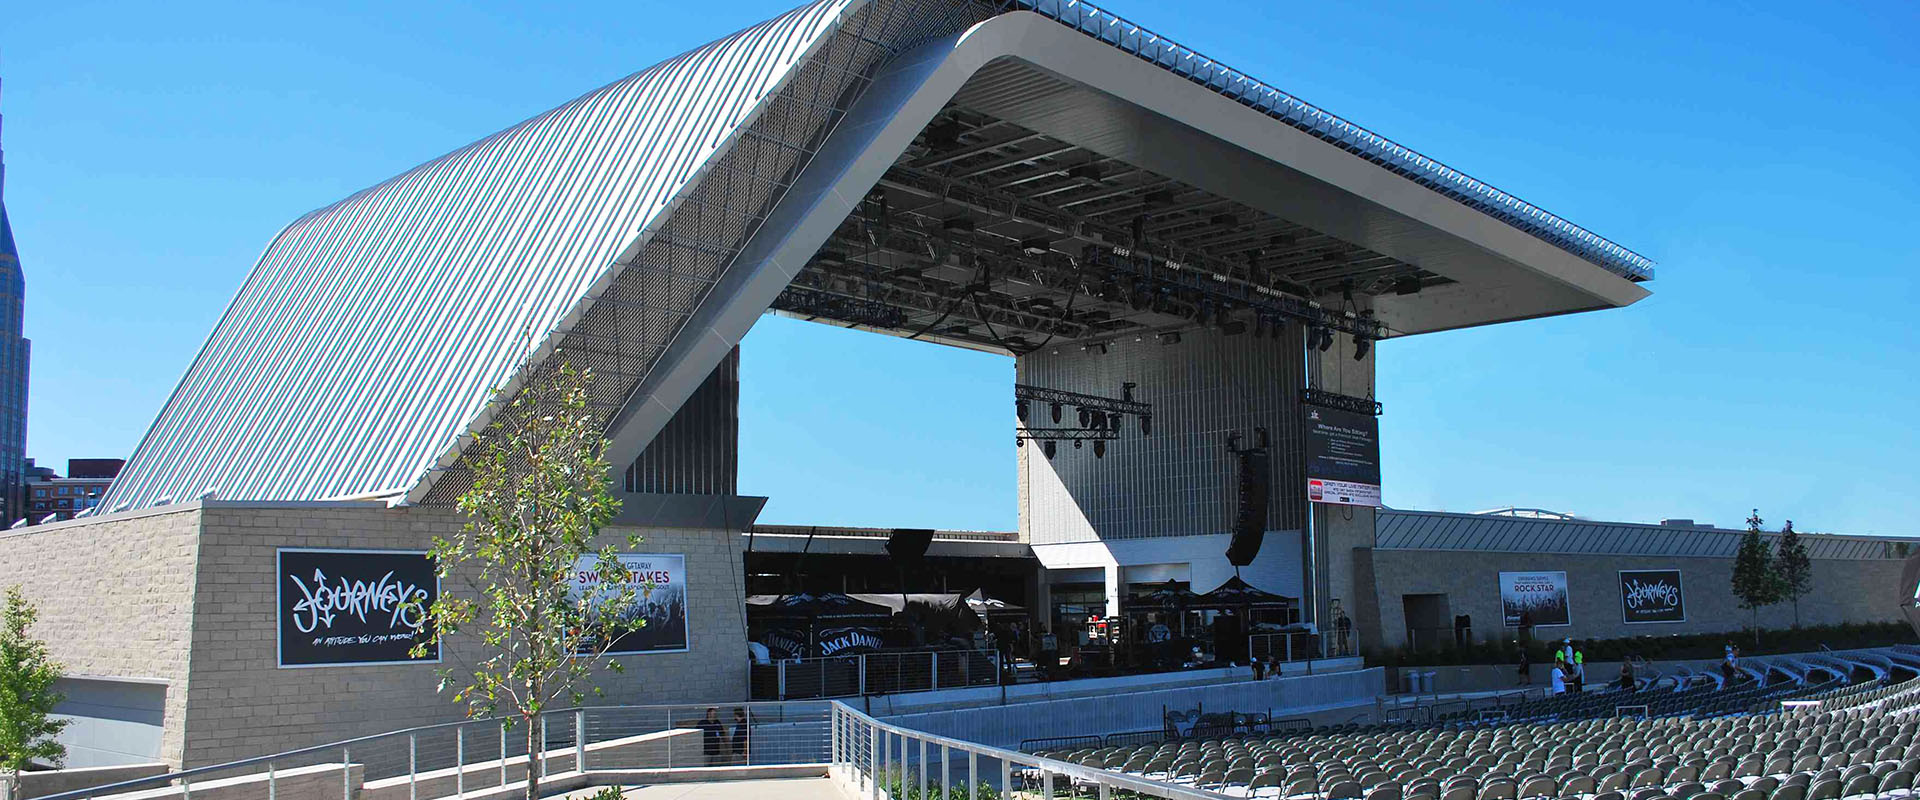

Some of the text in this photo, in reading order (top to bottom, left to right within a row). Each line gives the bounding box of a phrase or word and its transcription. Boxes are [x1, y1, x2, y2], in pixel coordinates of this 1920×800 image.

[1317, 423, 1333, 431] Where
[1342, 426, 1351, 434] You
[578, 571, 670, 584] SWTAKES
[1514, 584, 1554, 592] ROCK STAR
[1625, 579, 1678, 608] JOURNEYS
[290, 568, 428, 633] JOURNEYS
[312, 636, 323, 647] AN
[358, 633, 372, 645] YOU
[372, 634, 388, 645] CAN
[819, 636, 850, 656] JACK
